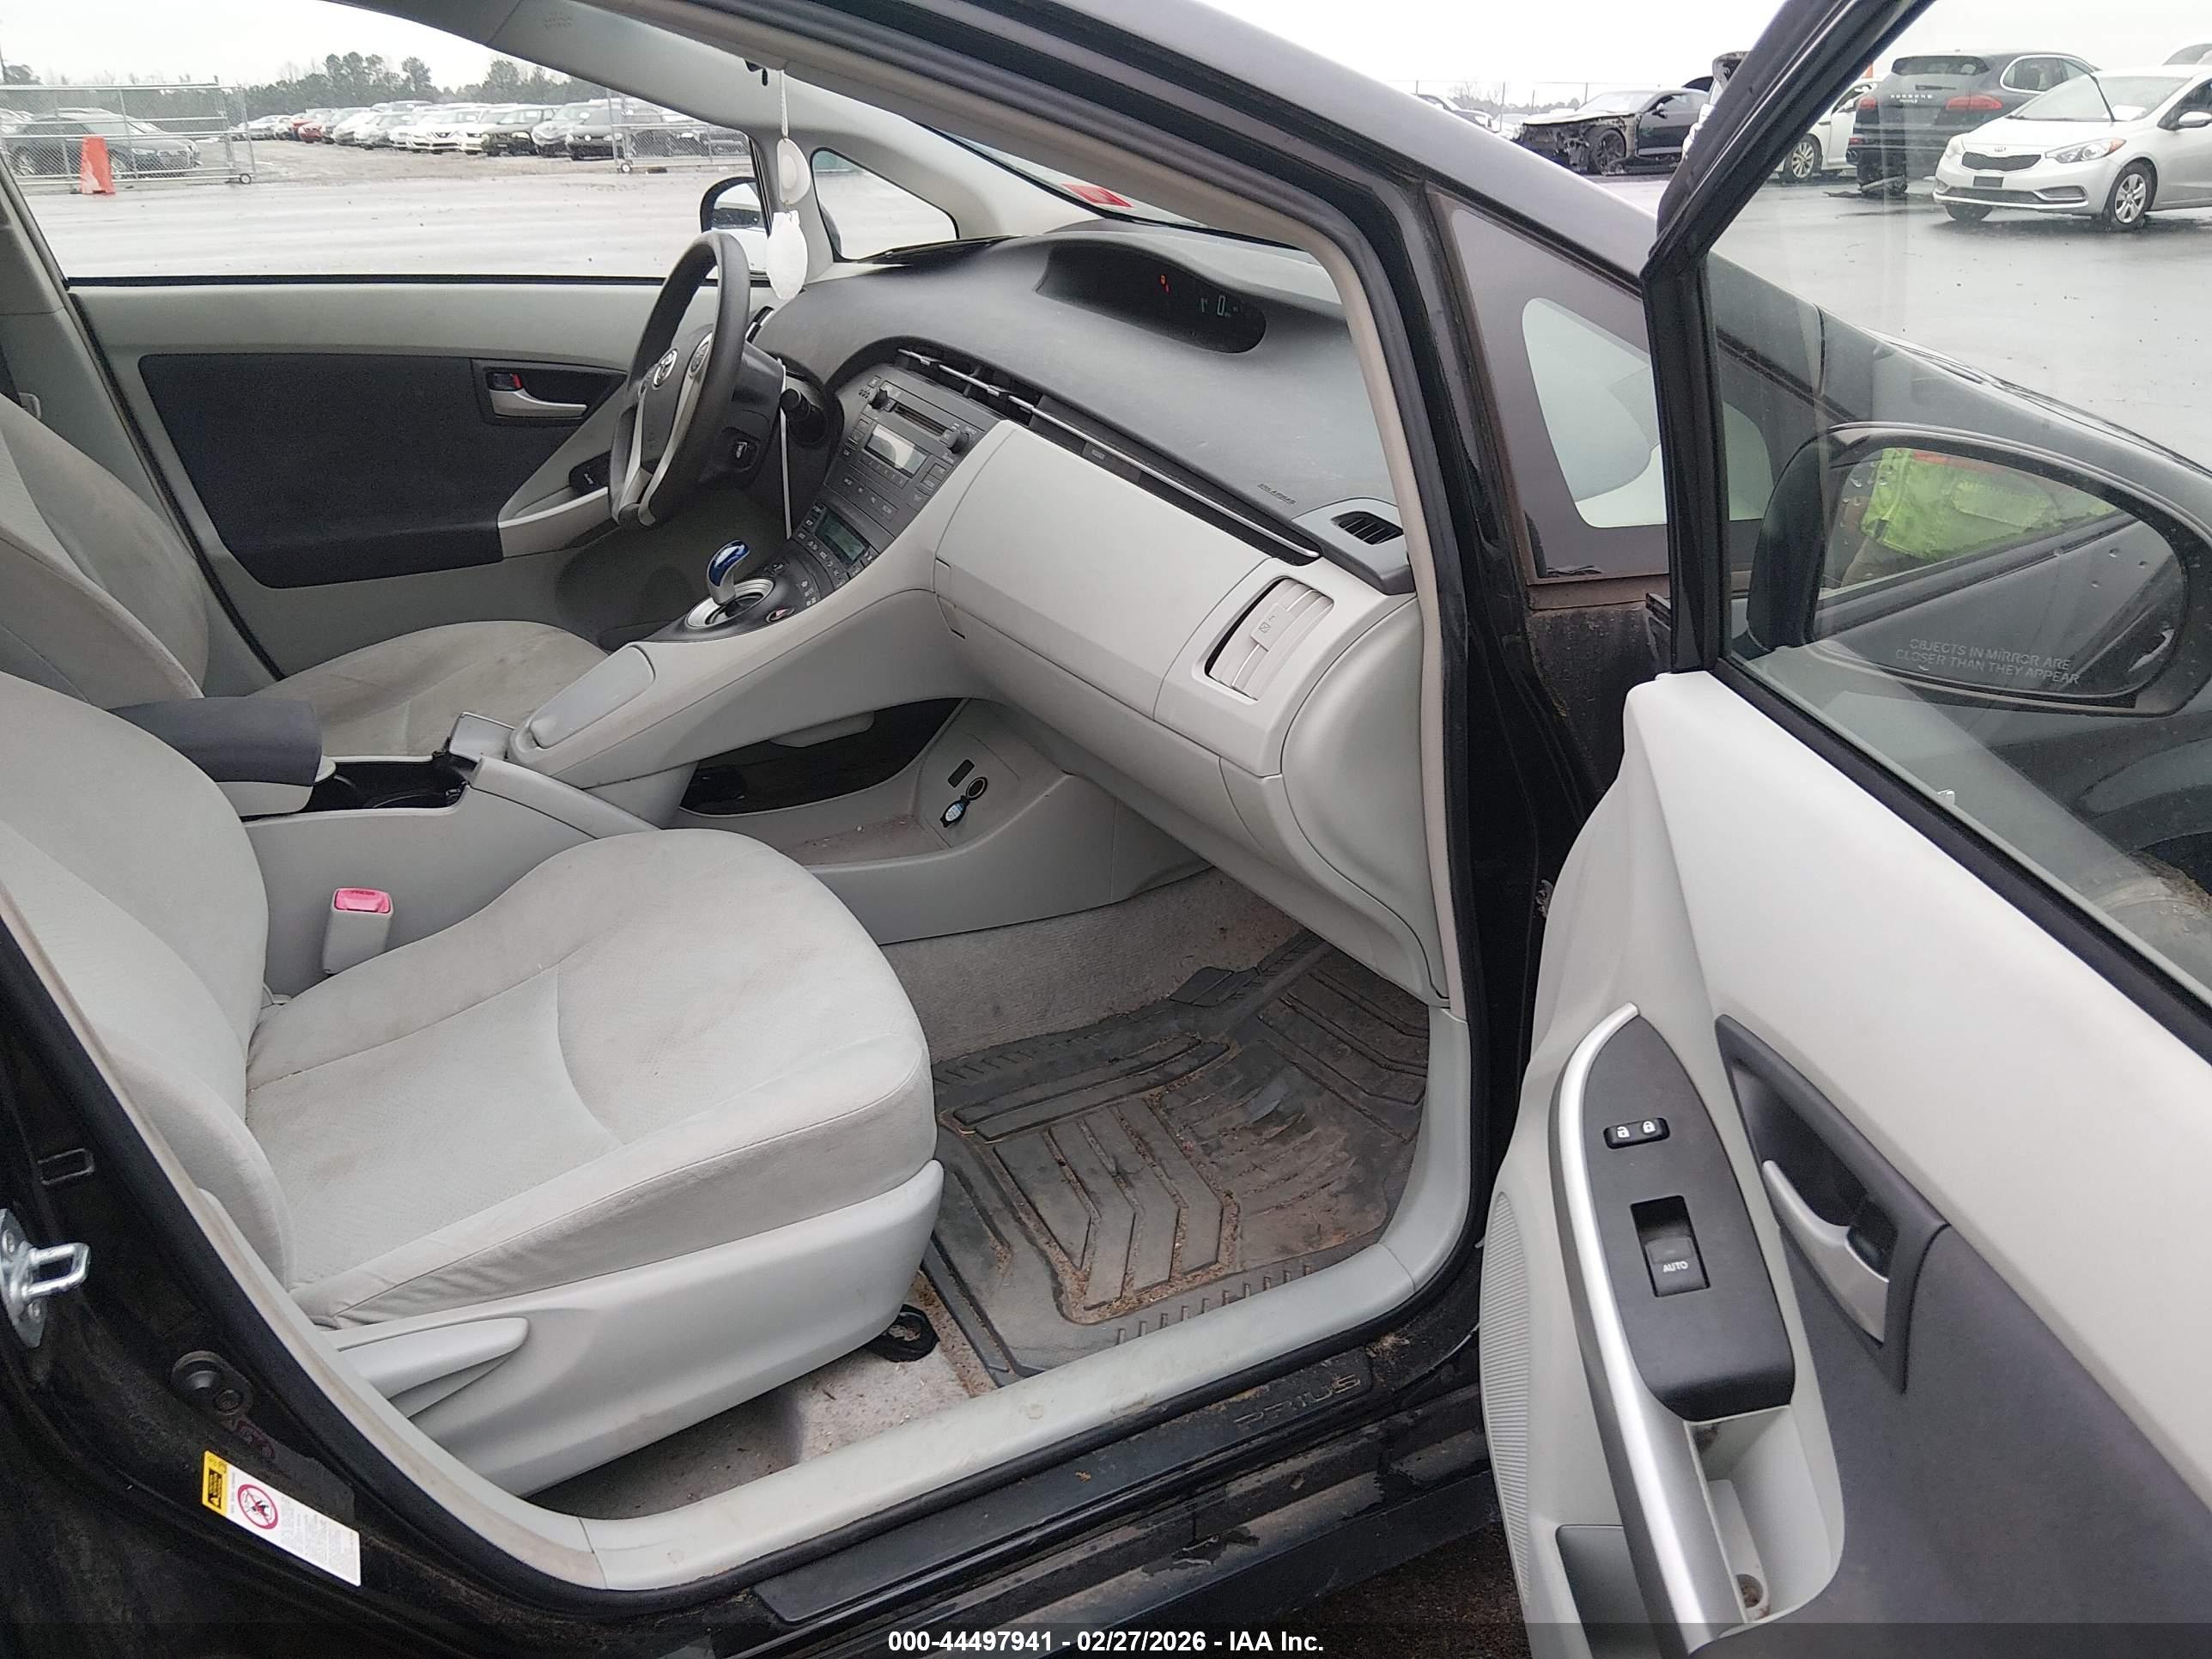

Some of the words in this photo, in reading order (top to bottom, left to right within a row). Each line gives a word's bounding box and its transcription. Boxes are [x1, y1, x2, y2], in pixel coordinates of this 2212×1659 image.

[1895, 649, 1947, 666] CLOSER
[1950, 657, 1986, 672] THAN
[1988, 662, 2021, 677] THEY
[2024, 667, 2081, 684] APPEAR
[1909, 638, 1966, 656] OBJECTS
[1969, 646, 1985, 659] IN
[1985, 648, 2040, 667] MIRROR
[2041, 657, 2071, 671] ARE
[1662, 1261, 1689, 1273] AUTO
